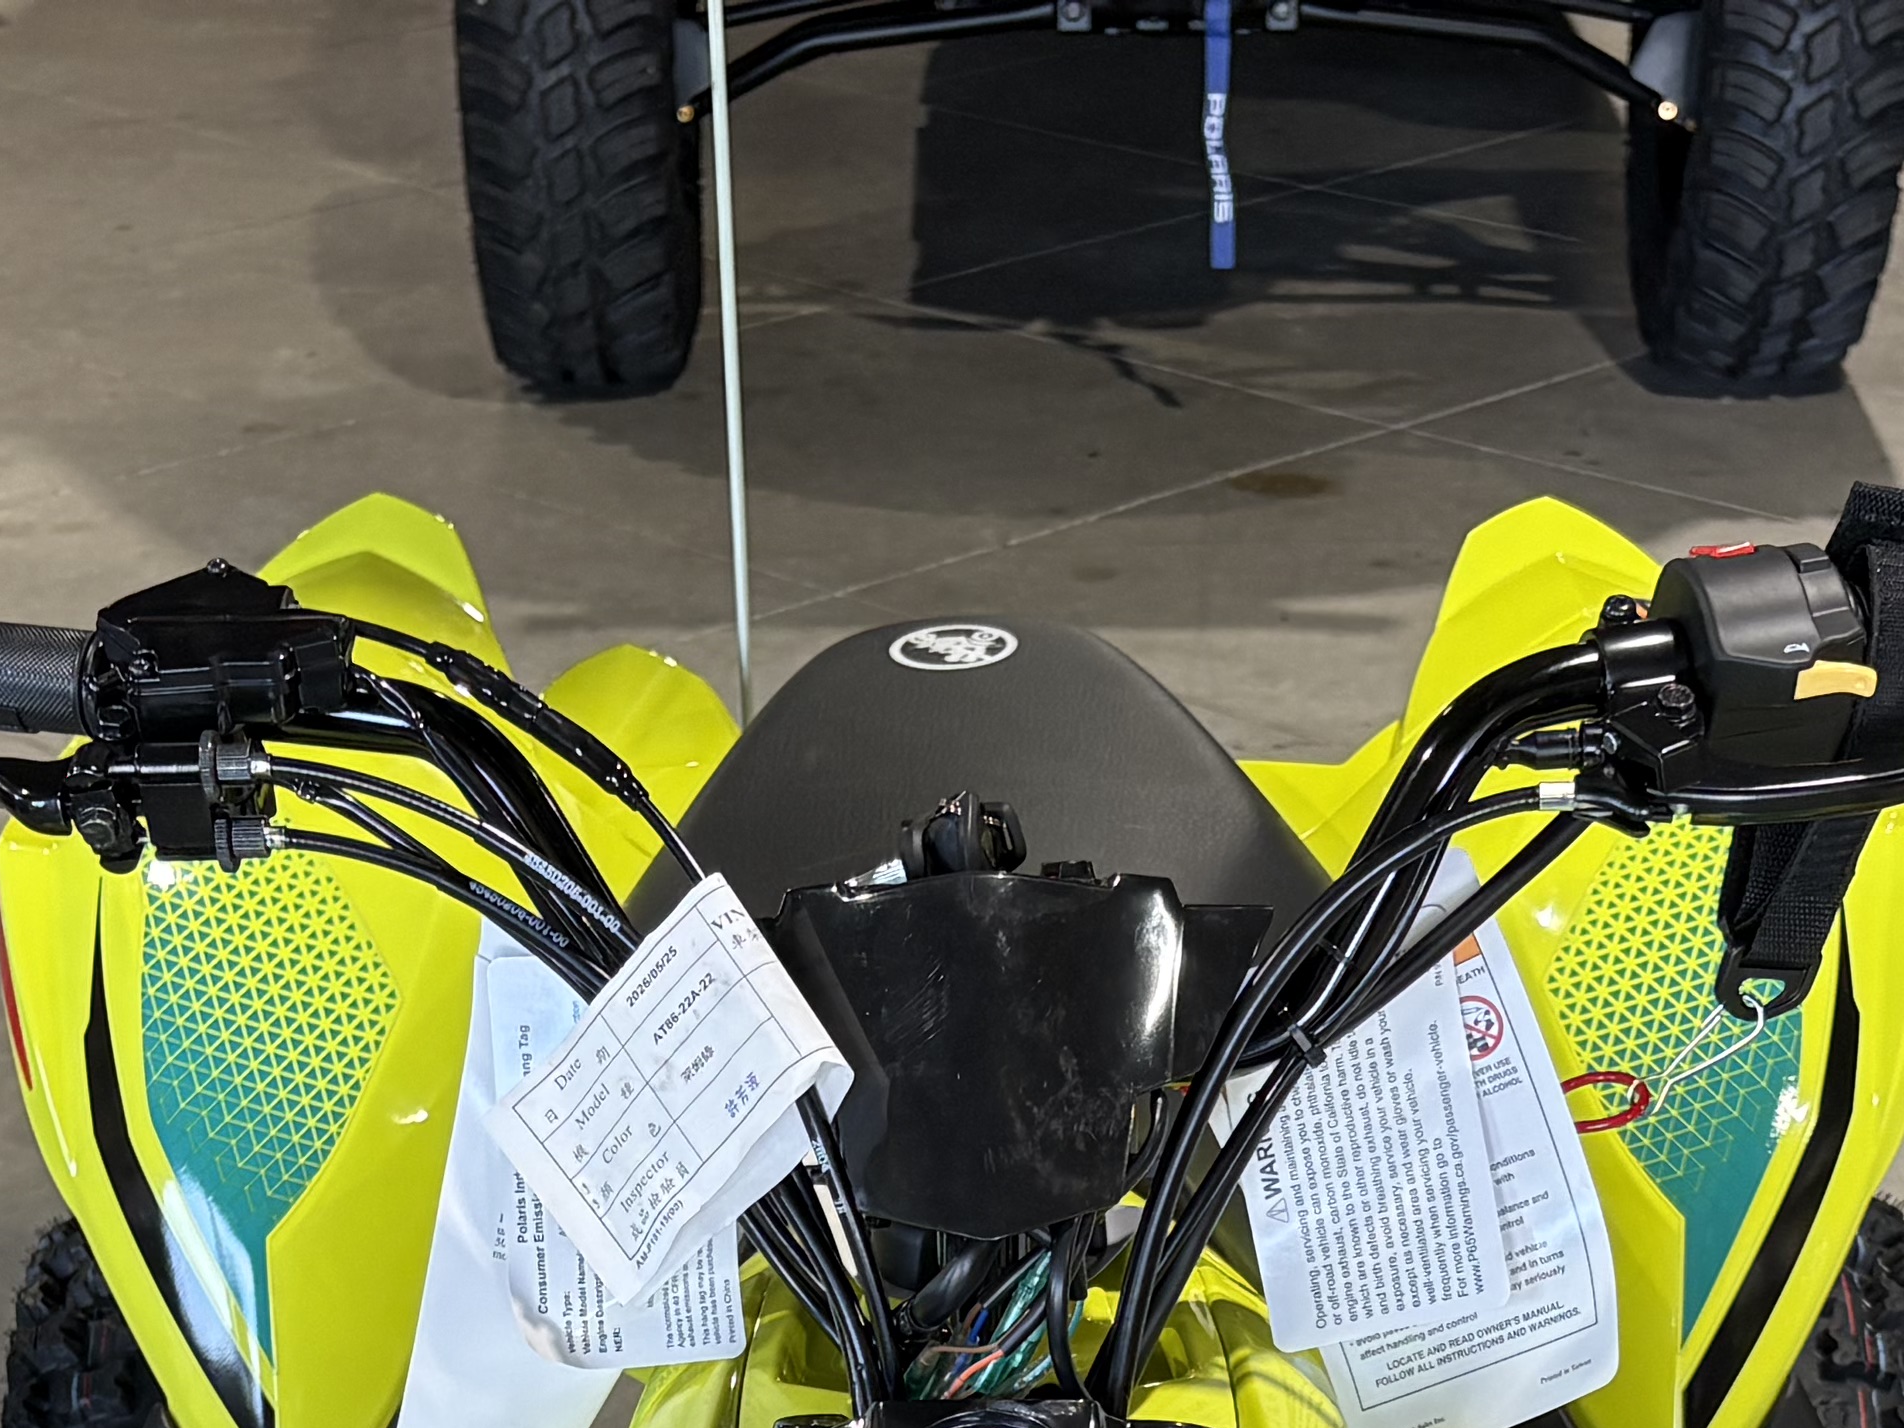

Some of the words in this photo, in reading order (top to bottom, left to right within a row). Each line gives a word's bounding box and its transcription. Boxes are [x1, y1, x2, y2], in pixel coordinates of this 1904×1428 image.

[1203, 91, 1234, 224] POLARIS
[518, 1024, 531, 1050] Tag
[1374, 1010, 1392, 1034] your
[1347, 1039, 1359, 1061] idle
[1364, 1037, 1374, 1046] a
[1365, 1047, 1376, 1060] in
[1379, 1036, 1394, 1069] wash
[554, 1058, 582, 1091] Date
[1335, 1053, 1347, 1088] harm.
[1350, 1061, 1363, 1082] not
[1386, 1070, 1397, 1084] or
[1487, 1065, 1519, 1084] DRUGS
[1492, 1056, 1512, 1070] USE
[1355, 1083, 1367, 1100] do
[1368, 1061, 1384, 1104] vehicle
[1402, 1068, 1420, 1115] vehicle.
[1481, 1077, 1523, 1098] ALCOHOL
[575, 1082, 610, 1131] Model
[1294, 1108, 1304, 1121] to
[1320, 1073, 1339, 1129] California
[1389, 1085, 1407, 1126] gloves
[1296, 1122, 1311, 1145] you
[1340, 1089, 1362, 1162] reproductive
[1358, 1102, 1377, 1154] exhaust,
[1376, 1106, 1393, 1133] your
[1412, 1118, 1428, 1146] your
[602, 1125, 633, 1164] Color
[1279, 1114, 1299, 1181] maintaining
[1312, 1118, 1332, 1179] monoxide,
[1329, 1131, 1342, 1144] of
[1397, 1129, 1411, 1159] wear
[1432, 1137, 1443, 1151] to
[1301, 1147, 1318, 1190] expose
[1334, 1145, 1349, 1178] State
[1382, 1135, 1399, 1179] service
[1401, 1161, 1416, 1185] and
[1435, 1152, 1449, 1169] go
[620, 1151, 669, 1213] Inspector
[1341, 1180, 1353, 1201] the
[1354, 1165, 1369, 1197] other
[1369, 1155, 1388, 1214] breathing
[1417, 1147, 1436, 1203] servicing
[1492, 1172, 1515, 1186] with
[1289, 1183, 1305, 1207] and
[1310, 1192, 1322, 1215] can
[1325, 1181, 1341, 1225] carbon
[1345, 1203, 1356, 1217] to
[1360, 1200, 1372, 1213] or
[1408, 1187, 1422, 1216] area
[1439, 1171, 1459, 1240] information
[1531, 1190, 1549, 1205] and
[516, 1197, 528, 1244] Polaris
[1392, 1182, 1411, 1247] necessary,
[1428, 1205, 1442, 1239] when
[1297, 1209, 1316, 1263] servicing
[1315, 1218, 1331, 1261] vehicle
[1348, 1218, 1363, 1259] known
[1364, 1215, 1380, 1260] defects
[1378, 1216, 1395, 1249] avoid
[1333, 1226, 1351, 1279] exhaust,
[1403, 1249, 1414, 1265] as
[1413, 1219, 1437, 1305] well-ventilated
[1451, 1242, 1465, 1274] more
[1528, 1259, 1539, 1269] in
[1538, 1250, 1565, 1265] turns
[536, 1246, 549, 1315] Consumer
[1321, 1263, 1340, 1310] off-road
[1356, 1260, 1368, 1281] are
[1371, 1262, 1385, 1290] birth
[1388, 1252, 1406, 1312] exposure,
[1433, 1242, 1452, 1301] frequently
[1524, 1265, 1566, 1286] seriously
[578, 1286, 588, 1317] Model
[1309, 1266, 1328, 1329] Operating,
[1343, 1281, 1359, 1322] engine
[1358, 1283, 1374, 1319] which
[1375, 1291, 1390, 1315] and
[1405, 1267, 1422, 1308] except
[1456, 1277, 1469, 1298] For
[1332, 1313, 1343, 1326] or
[1360, 1345, 1386, 1361] affect
[1385, 1332, 1426, 1351] handling
[1427, 1323, 1445, 1337] and
[1445, 1311, 1478, 1330] control
[1375, 1366, 1415, 1388] FOLLOW
[1417, 1361, 1436, 1373] ALL
[1436, 1335, 1505, 1366] INSTRUCTIONS
[1506, 1326, 1527, 1341] AND
[1528, 1307, 1581, 1333] WARNINGS.
[1386, 1349, 1425, 1371] LOCATE
[1426, 1342, 1447, 1357] AND
[1448, 1332, 1475, 1349] READ
[1476, 1315, 1521, 1339] OWNER'S
